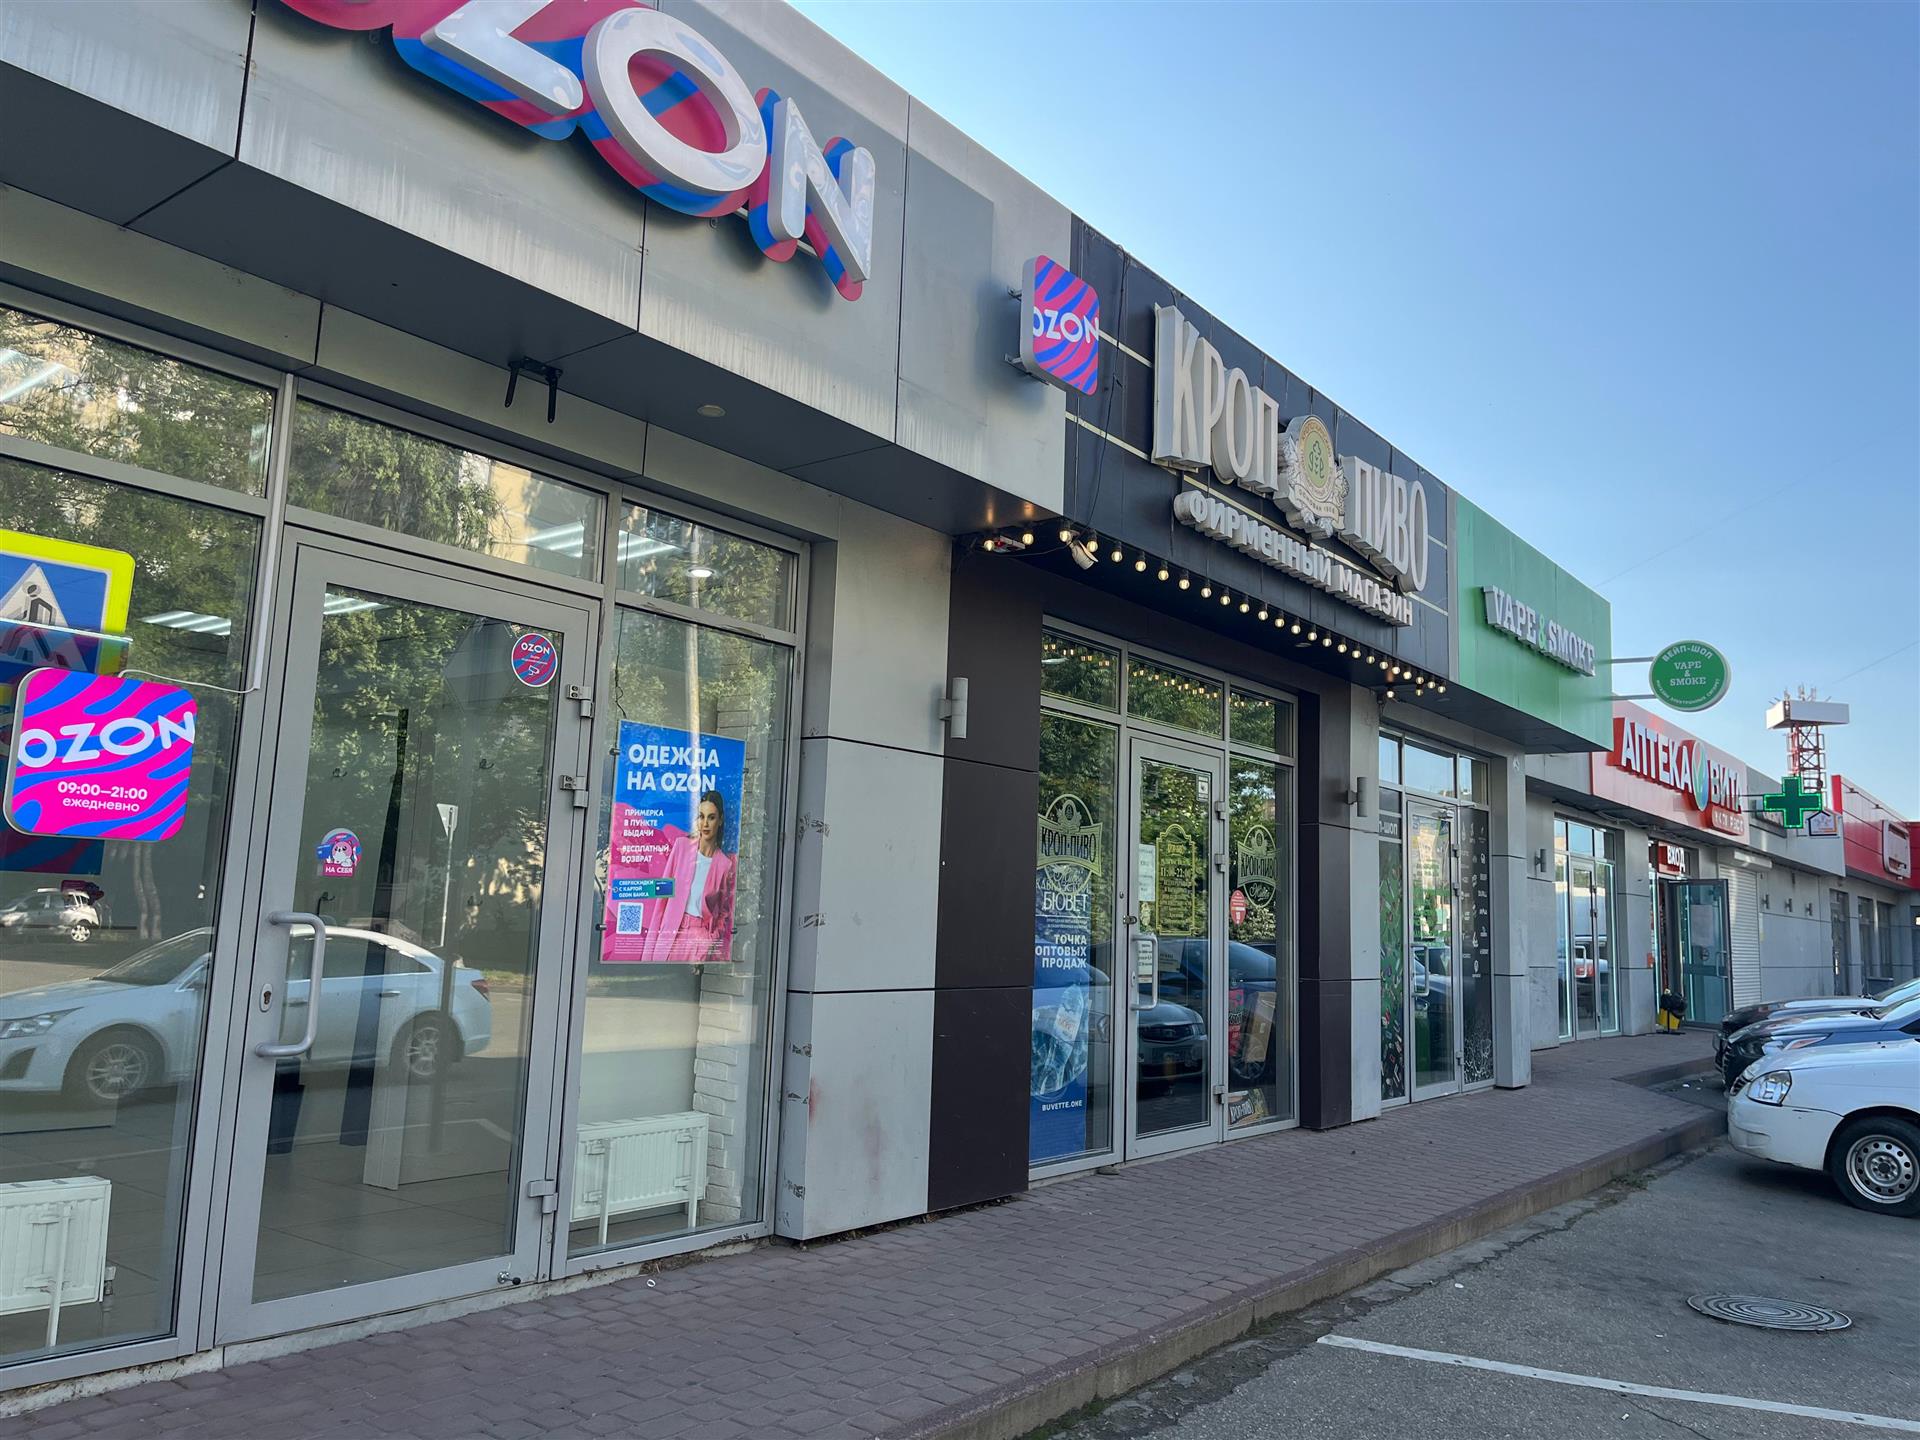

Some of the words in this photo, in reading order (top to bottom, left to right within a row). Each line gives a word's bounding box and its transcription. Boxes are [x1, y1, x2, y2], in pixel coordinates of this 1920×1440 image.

[1033, 306, 1099, 344] OZON
[1155, 303, 1280, 493] КРОП
[1341, 454, 1428, 593] ПИВО
[1332, 564, 1414, 627] МАГАЗИН
[1485, 585, 1537, 646] VAPE
[1547, 619, 1596, 677] SMOKE
[521, 642, 550, 655] OZON
[1674, 661, 1702, 670] VAPE
[1684, 669, 1691, 677] &
[1669, 676, 1706, 687] SMOKE
[17, 711, 196, 769] OZON
[628, 744, 720, 770] ОДЕЖДА
[1621, 717, 1693, 794] АПТЕКА
[627, 771, 657, 791] НА
[660, 772, 716, 793] OZON
[62, 796, 140, 813] ежедневно
[624, 809, 664, 817] ПРИМЕРКА
[630, 819, 658, 827] ПУНКТЕ
[622, 844, 670, 853] БЕСПЛАТНЫЙ
[621, 856, 653, 864] ВОЗВРАТ
[1666, 845, 1686, 873] ВХОД
[1042, 891, 1088, 912] БЮВЕТ
[1054, 934, 1087, 945] ТОЧКА
[1035, 945, 1087, 957] ОПТОВЫХ
[1042, 957, 1087, 970] ПРОДАЖ
[1042, 1100, 1082, 1112] BUVETTE.ONE
